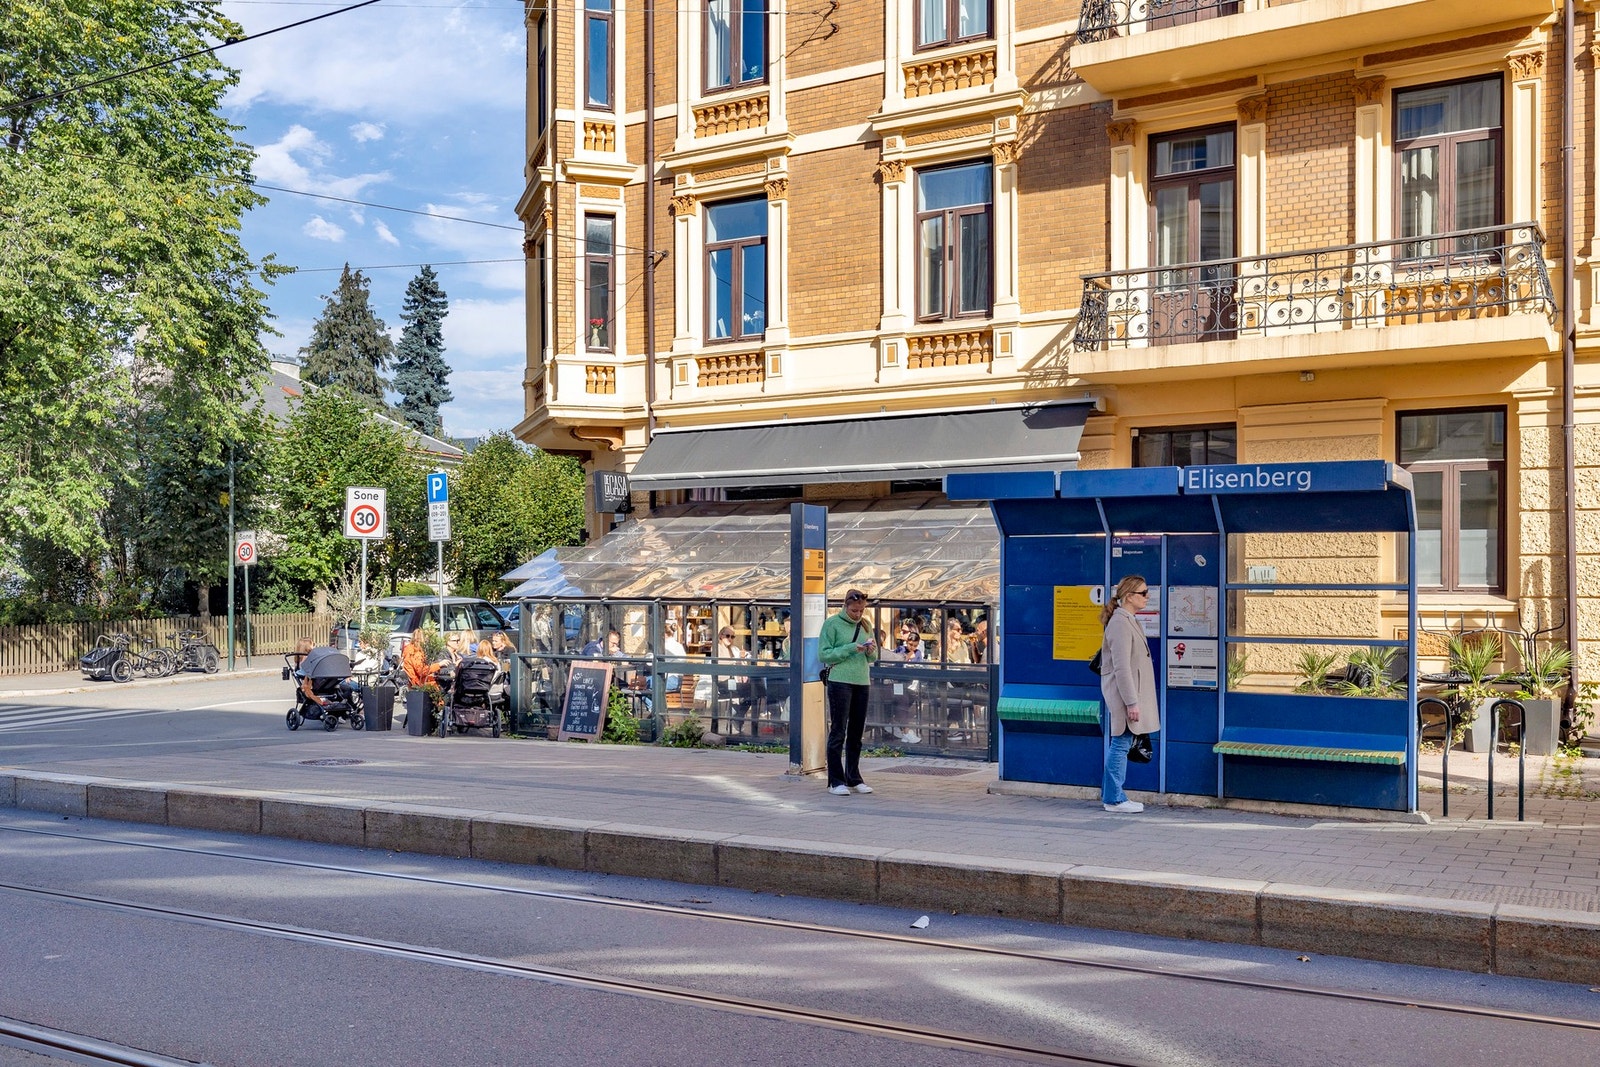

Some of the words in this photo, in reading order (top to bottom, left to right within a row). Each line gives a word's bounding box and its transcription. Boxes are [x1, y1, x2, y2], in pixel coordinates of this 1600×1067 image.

[609, 474, 628, 496] CASA
[1188, 466, 1311, 491] Elisenberg
[353, 490, 379, 501] Sone
[432, 477, 442, 499] P
[356, 512, 375, 527] 30
[241, 547, 250, 556] 30
